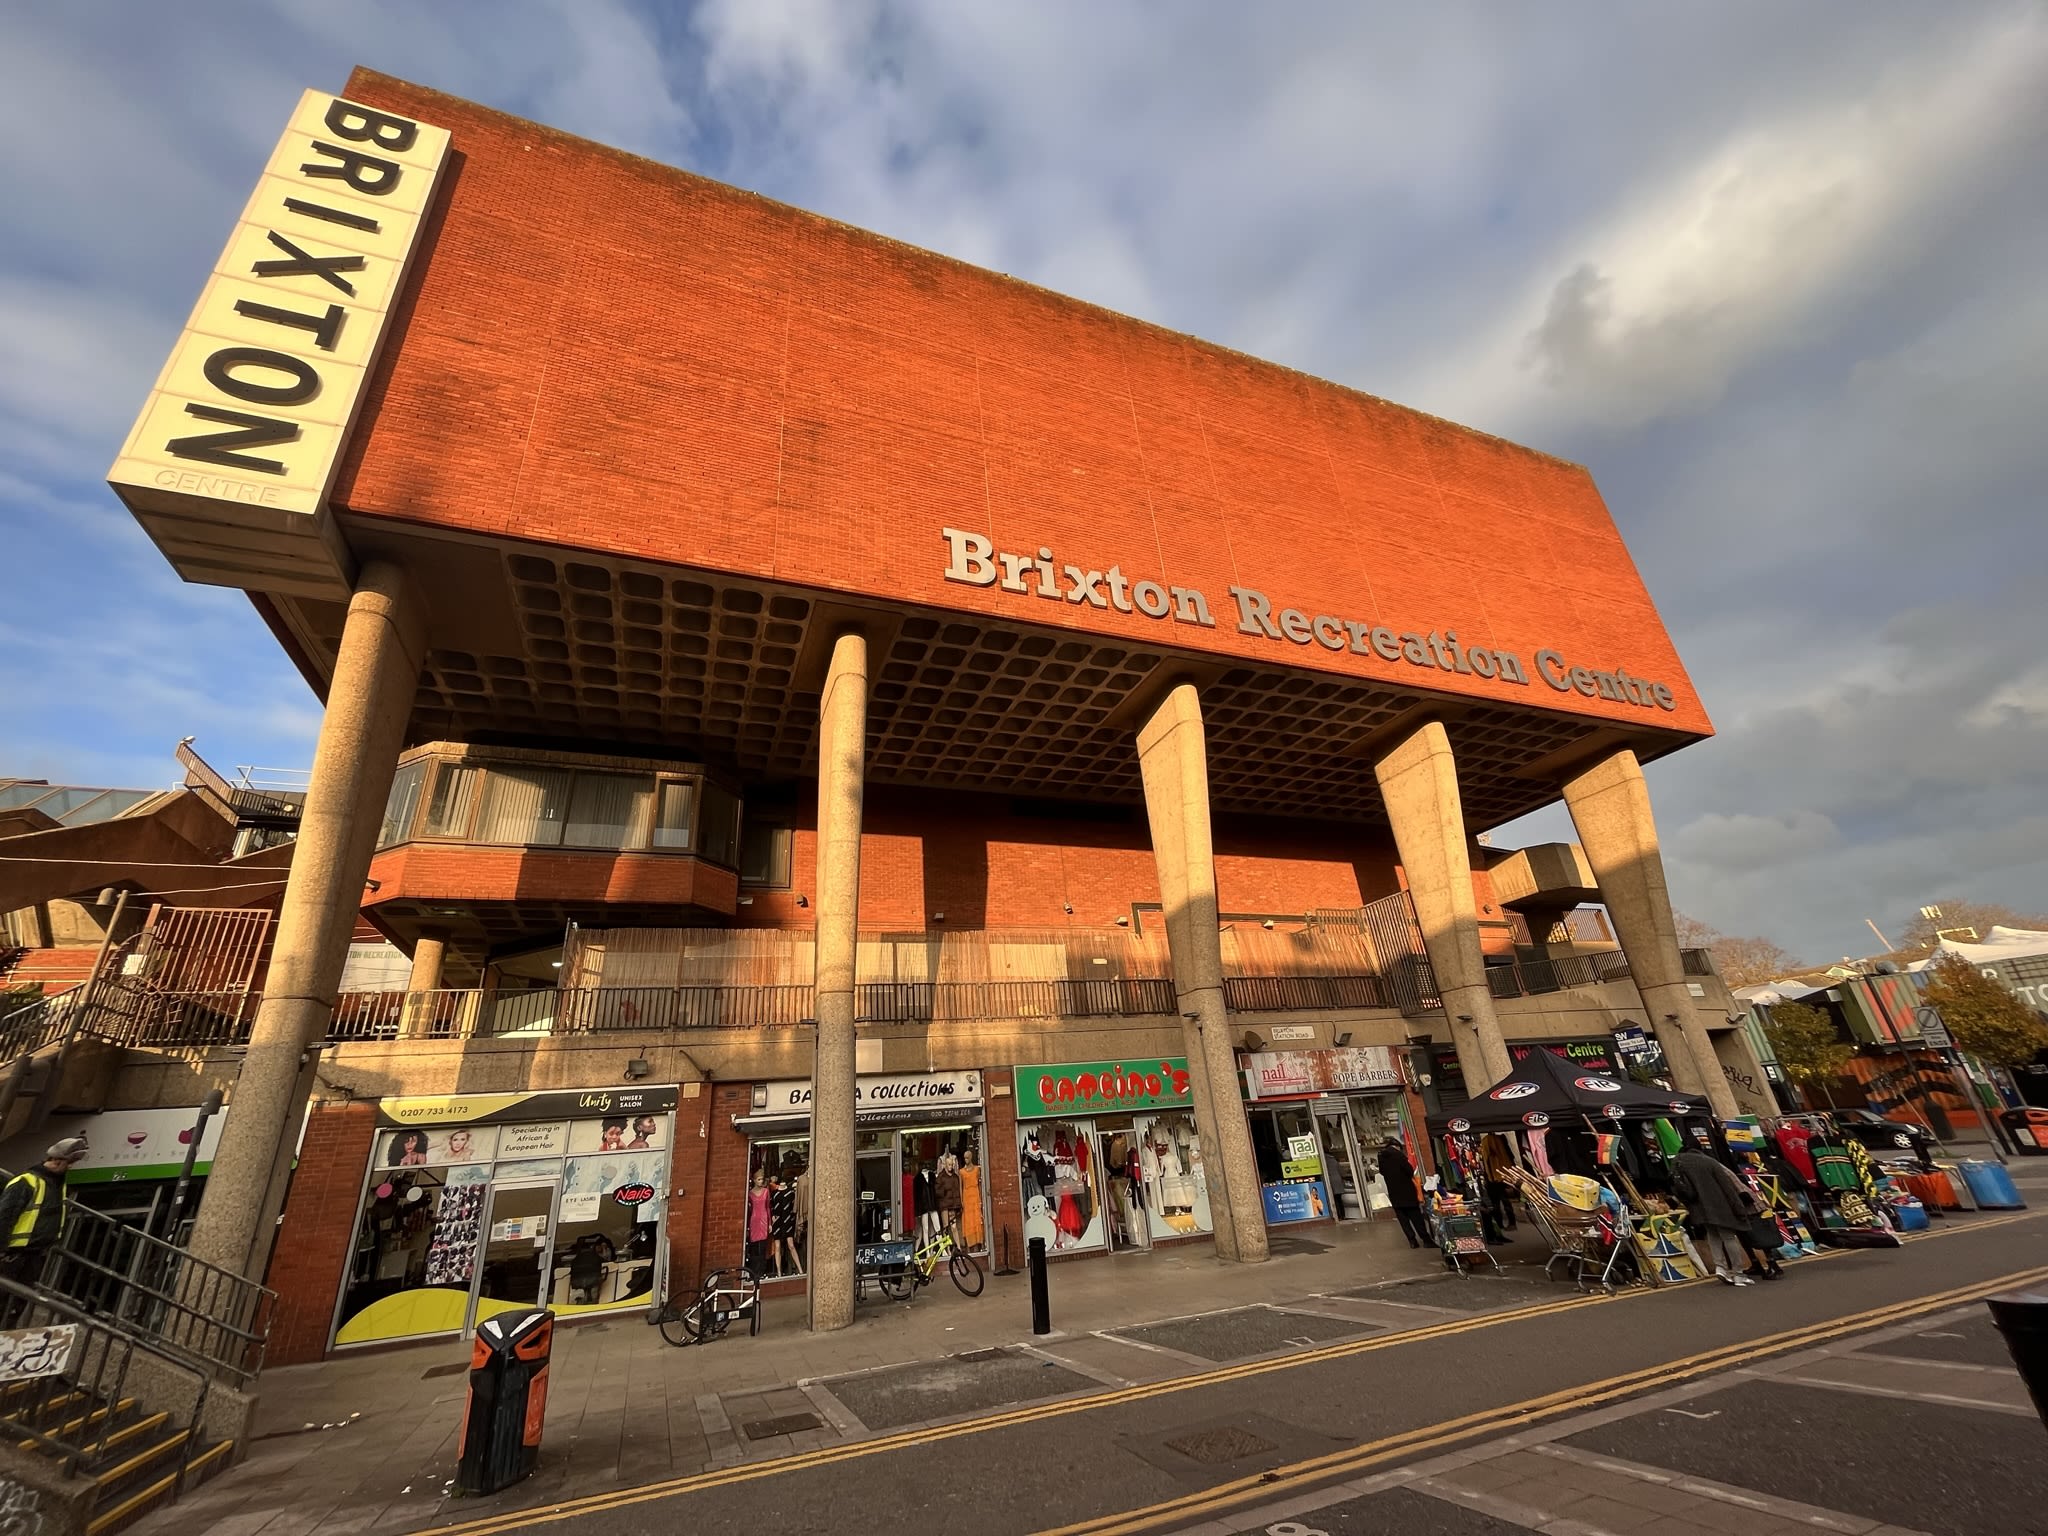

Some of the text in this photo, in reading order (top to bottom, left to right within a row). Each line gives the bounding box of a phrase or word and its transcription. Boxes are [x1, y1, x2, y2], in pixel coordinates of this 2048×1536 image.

[164, 98, 418, 476] BRIXTON
[154, 469, 281, 505] CENTRE
[942, 526, 1676, 711] Brixton Recreation Centre
[1566, 1042, 1606, 1058] Centre
[1261, 1063, 1286, 1080] nail
[1332, 1069, 1399, 1083] POPE BARBERS
[579, 1092, 612, 1112] Unity
[400, 1106, 468, 1117] 0207 733 4173
[516, 1134, 543, 1142] African
[505, 1144, 539, 1152] European
[614, 1187, 653, 1201] Nails
